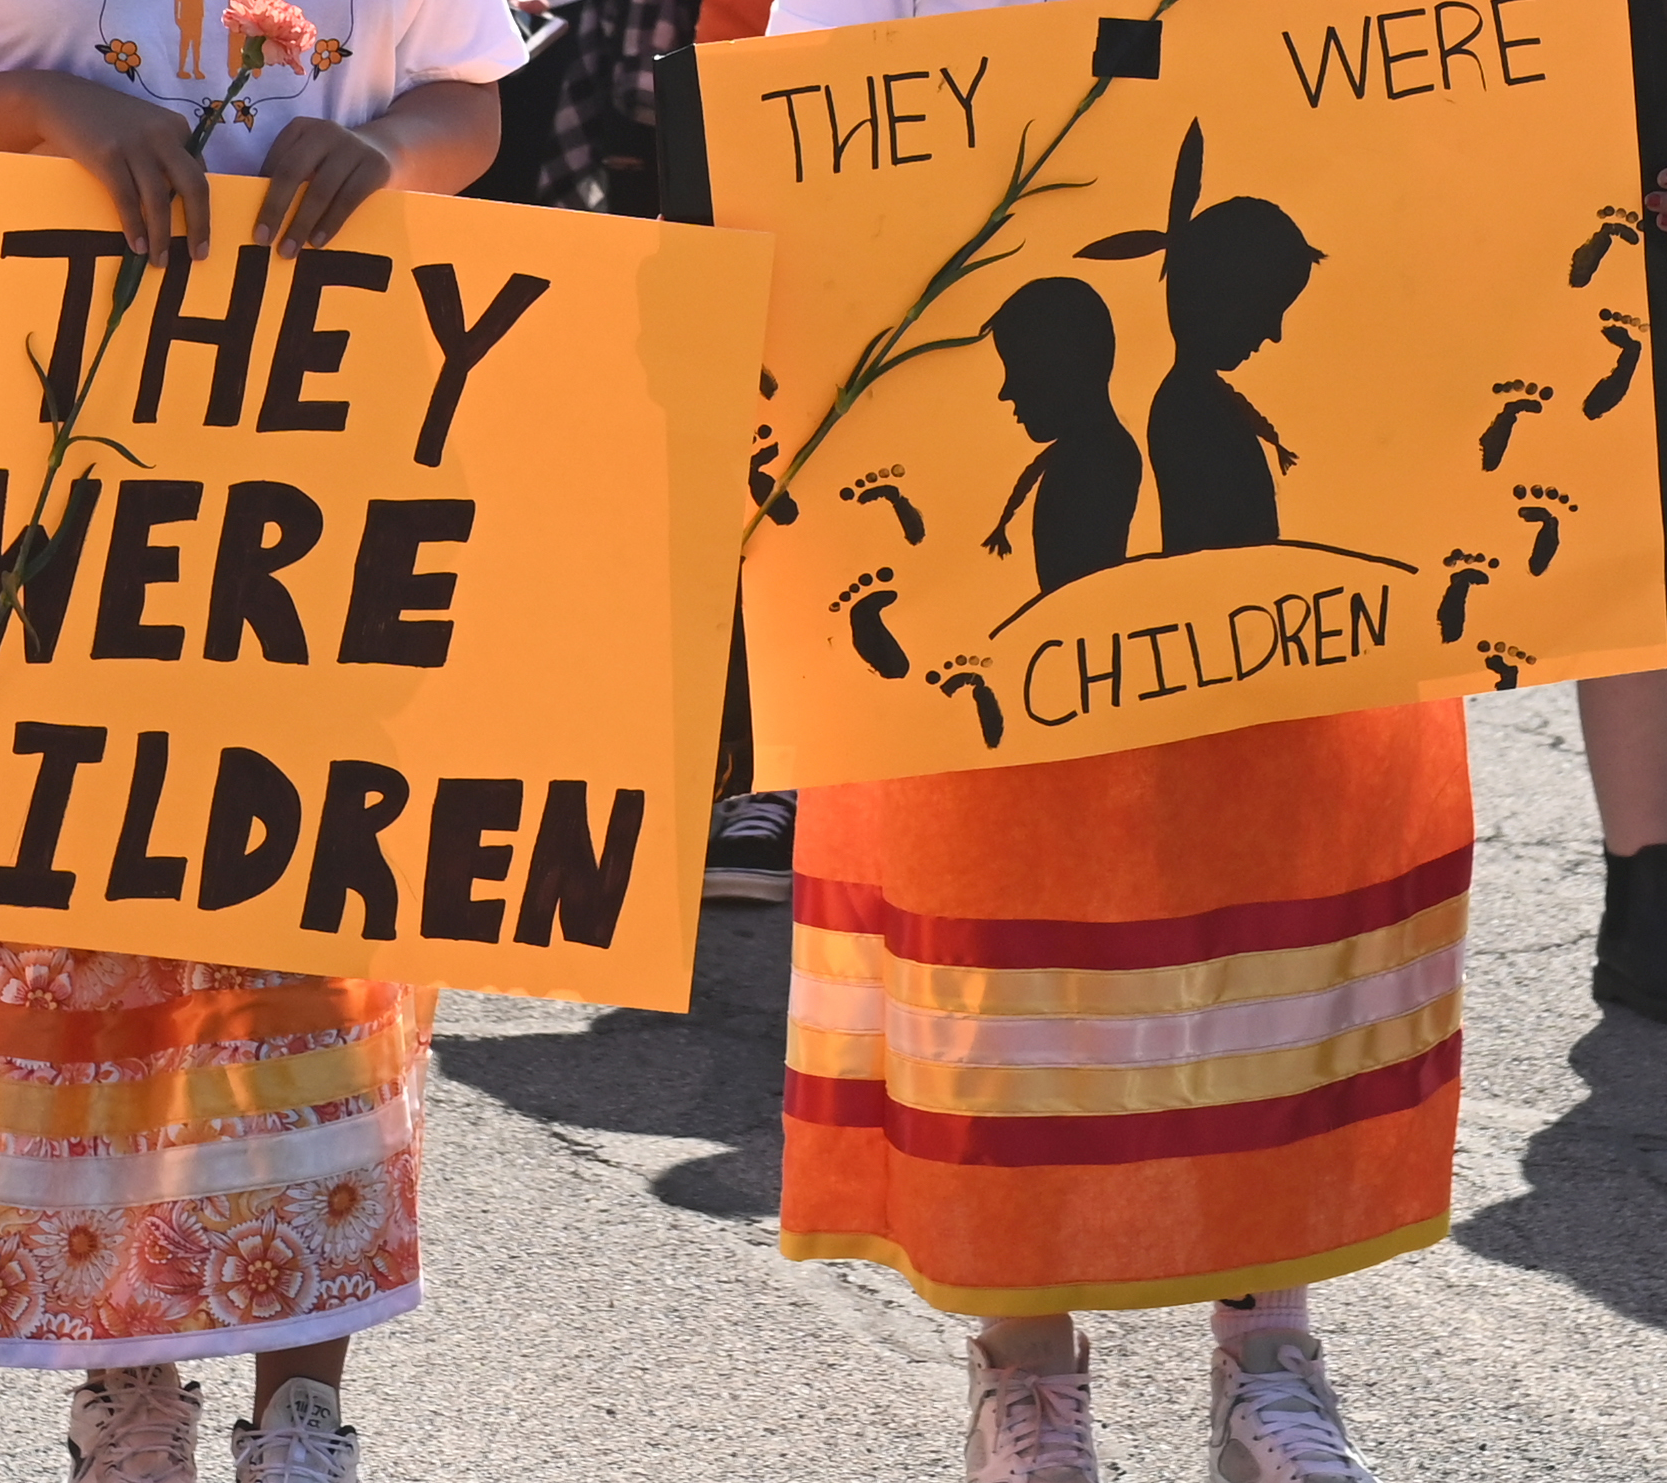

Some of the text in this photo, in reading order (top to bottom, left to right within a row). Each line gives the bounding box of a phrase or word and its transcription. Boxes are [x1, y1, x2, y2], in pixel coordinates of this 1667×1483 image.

[761, 56, 990, 183] THEY
[0, 229, 551, 468] THEY
[1024, 584, 1389, 727] CHILDREN
